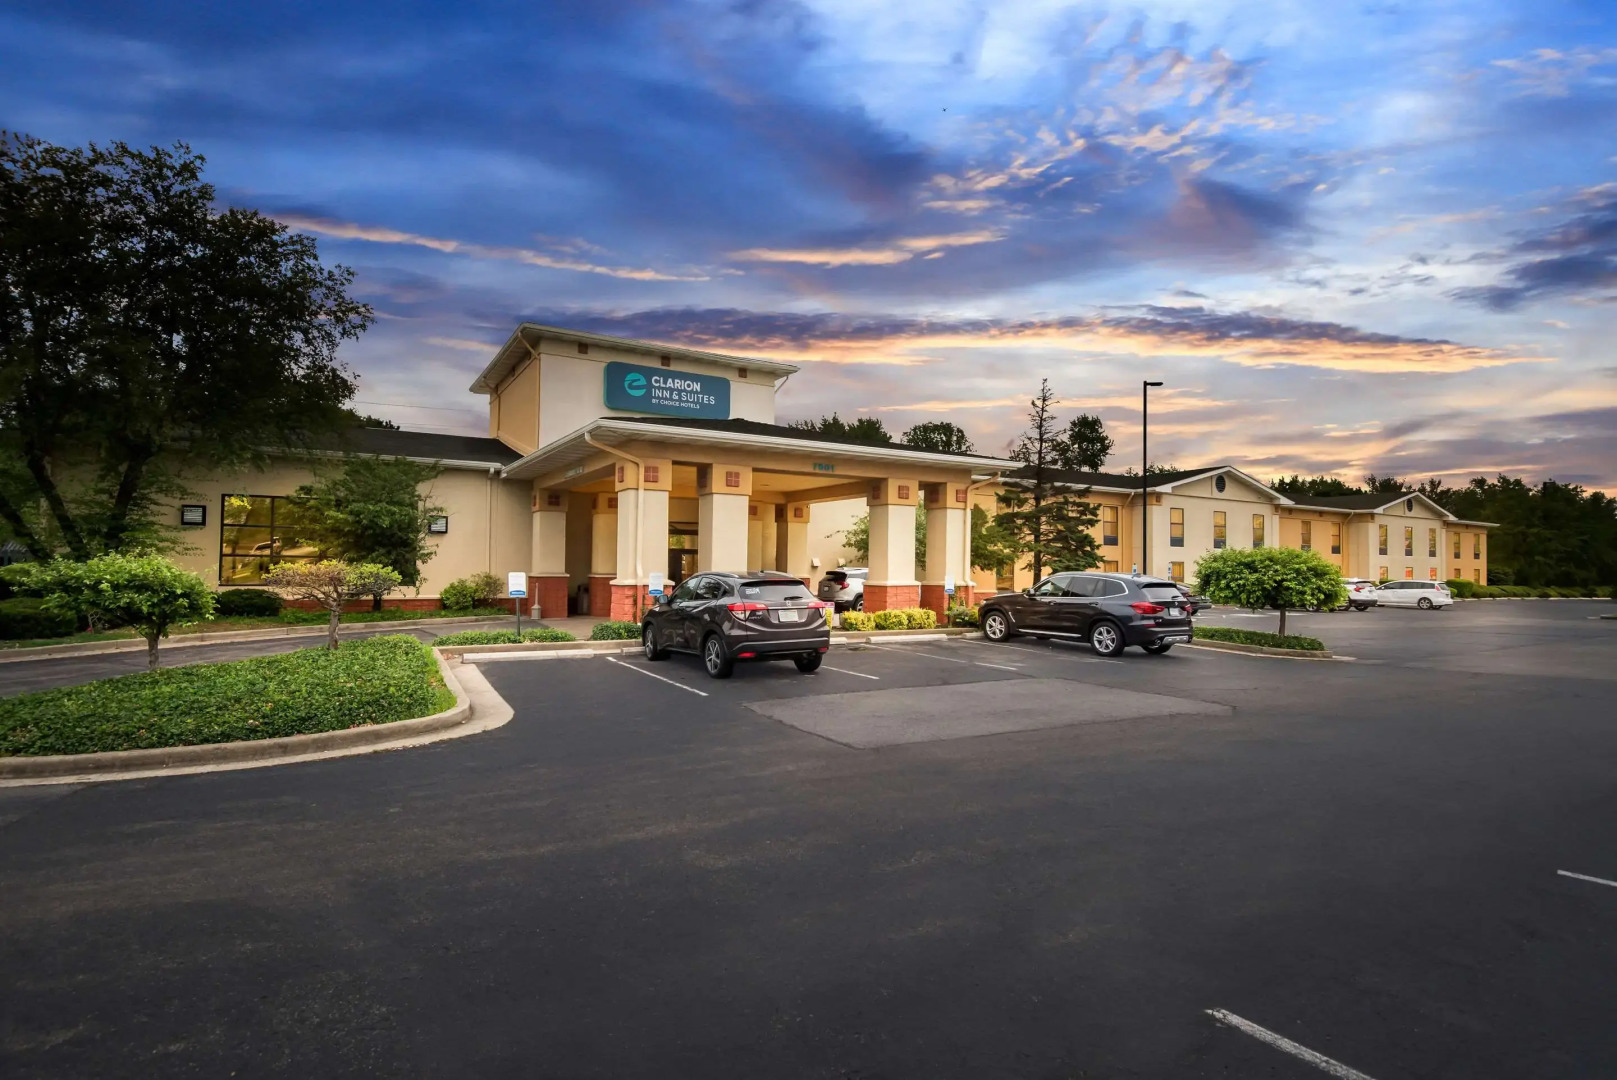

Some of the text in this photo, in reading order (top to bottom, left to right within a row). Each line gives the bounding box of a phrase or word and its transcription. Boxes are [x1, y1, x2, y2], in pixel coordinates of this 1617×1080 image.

[651, 376, 701, 392] CLARION
[651, 388, 715, 405] INN & SUITES
